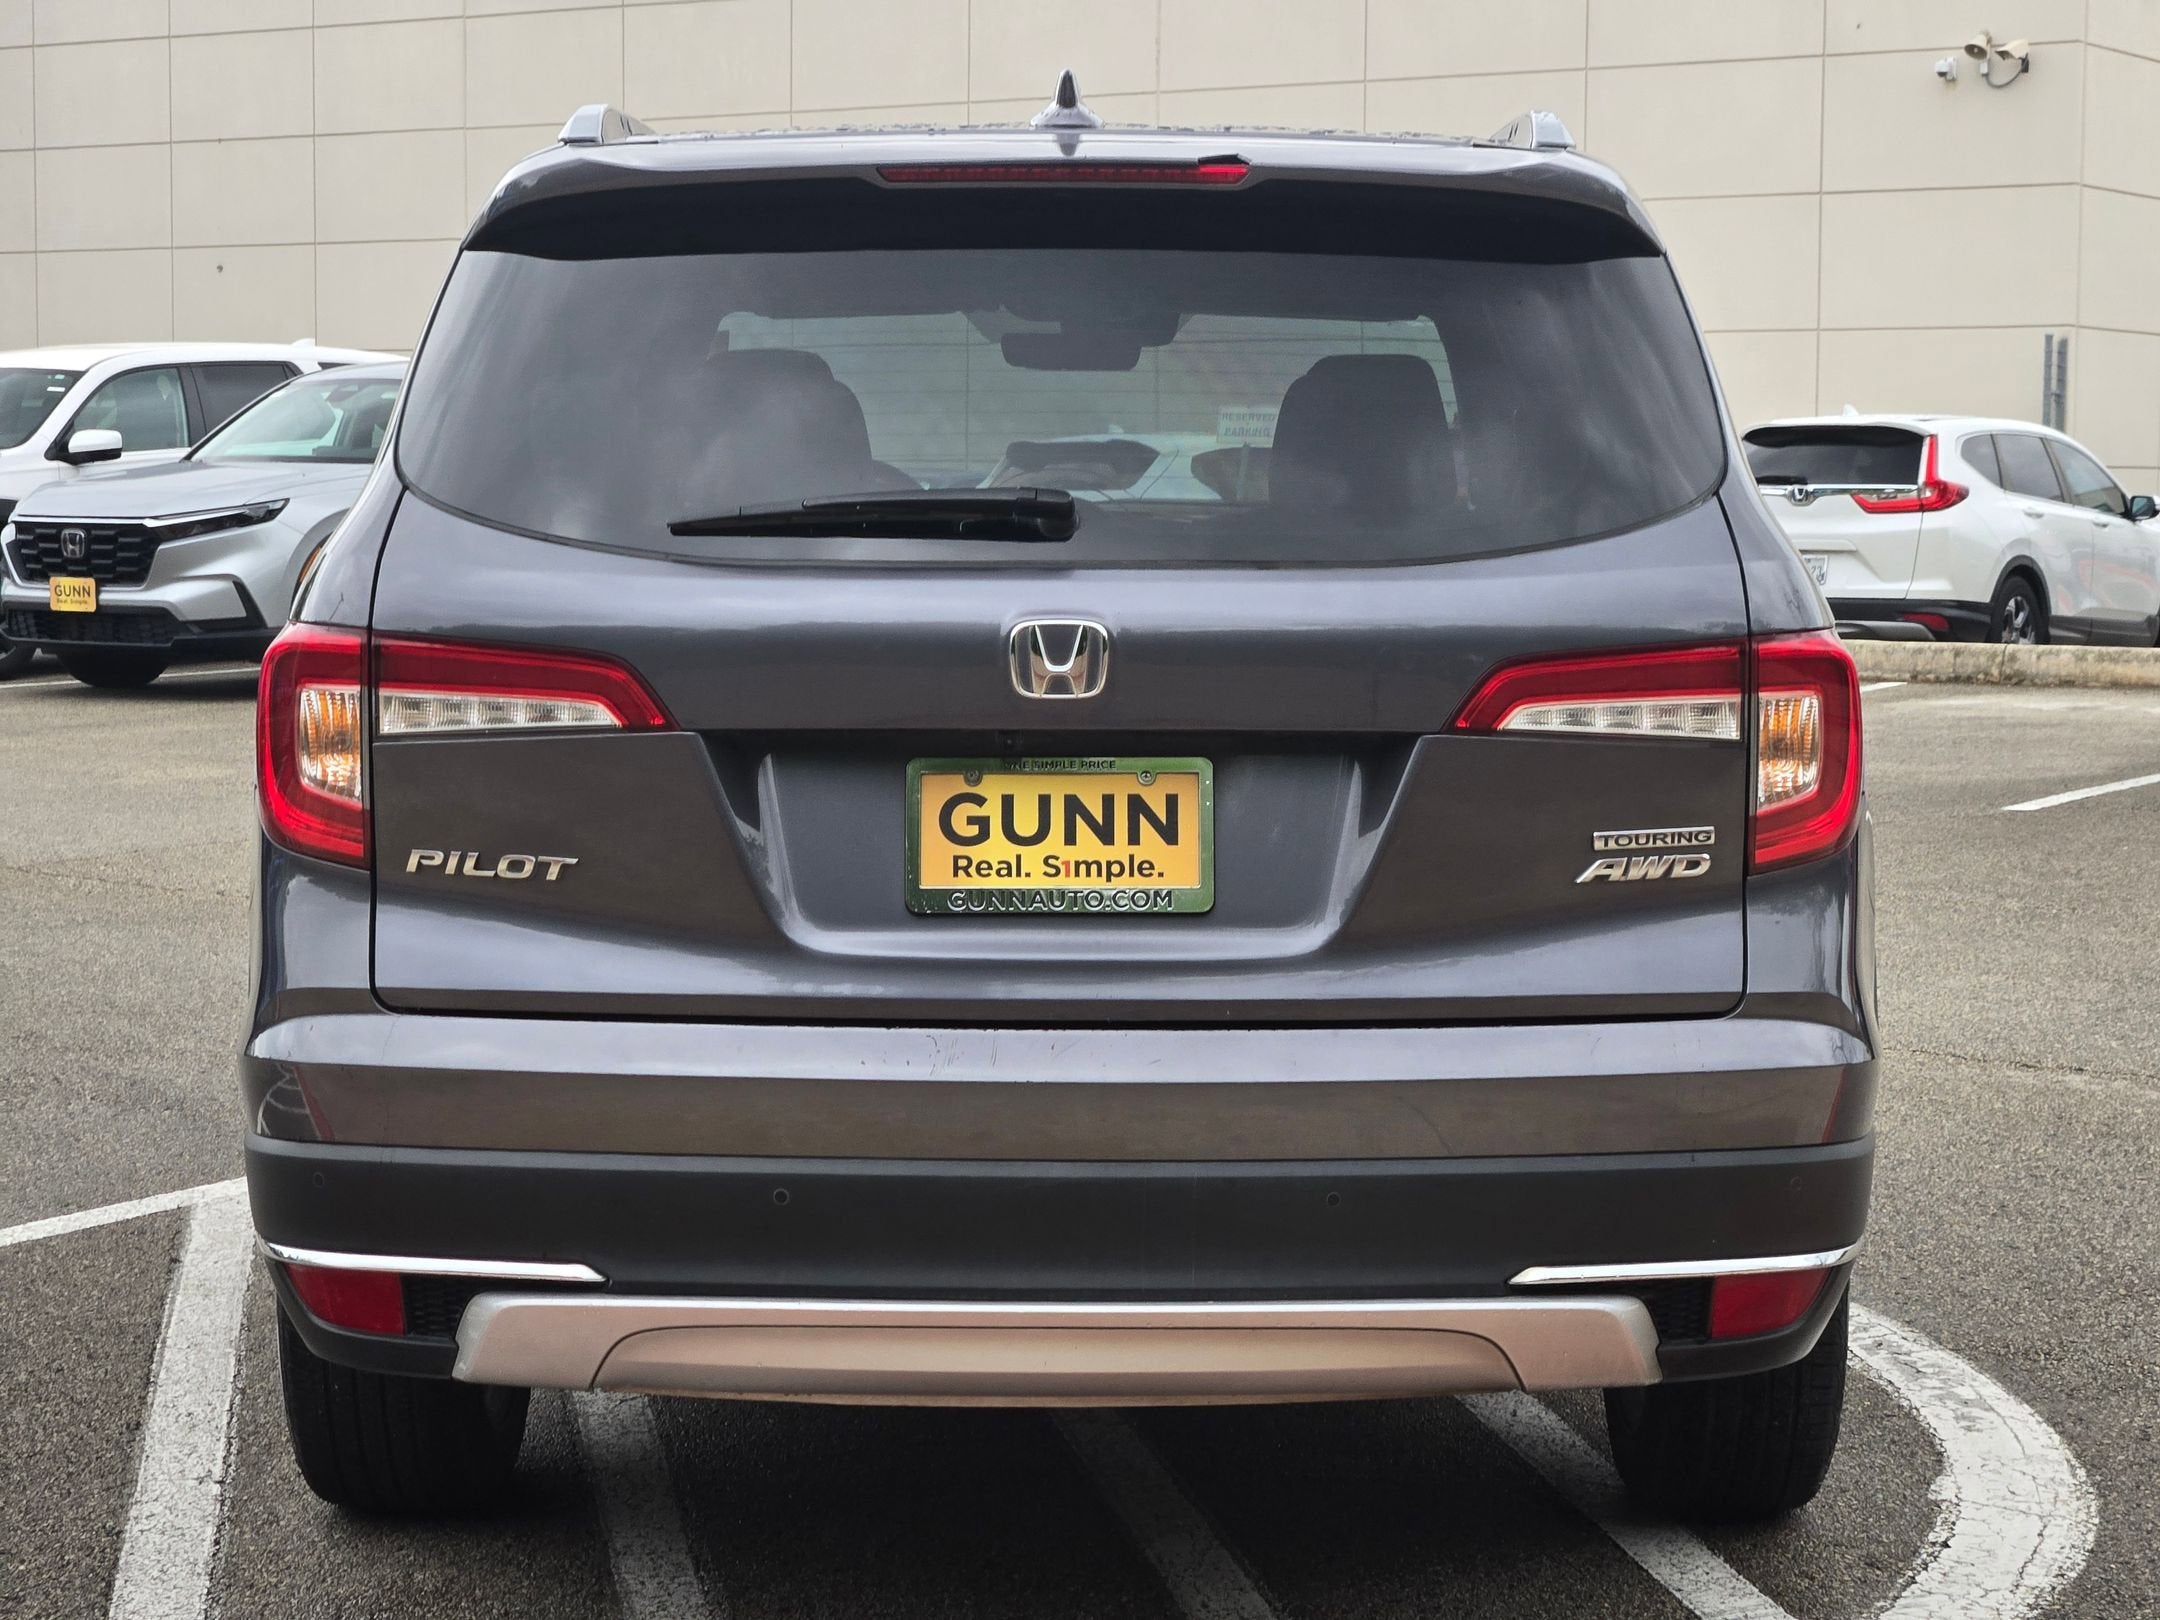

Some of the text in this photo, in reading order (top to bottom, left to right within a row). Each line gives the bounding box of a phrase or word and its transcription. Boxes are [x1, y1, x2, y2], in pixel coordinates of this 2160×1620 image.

[54, 584, 91, 598] GUNN
[1033, 760, 1077, 769] SIMPLE
[1080, 759, 1116, 769] PRICE
[938, 792, 1179, 847] GUNN
[1597, 830, 1712, 848] TOURING
[405, 849, 579, 881] PILOT
[952, 854, 1032, 878] Real.
[1574, 853, 1712, 884] AWD
[947, 889, 1174, 912] GUNNAUTO.COM
